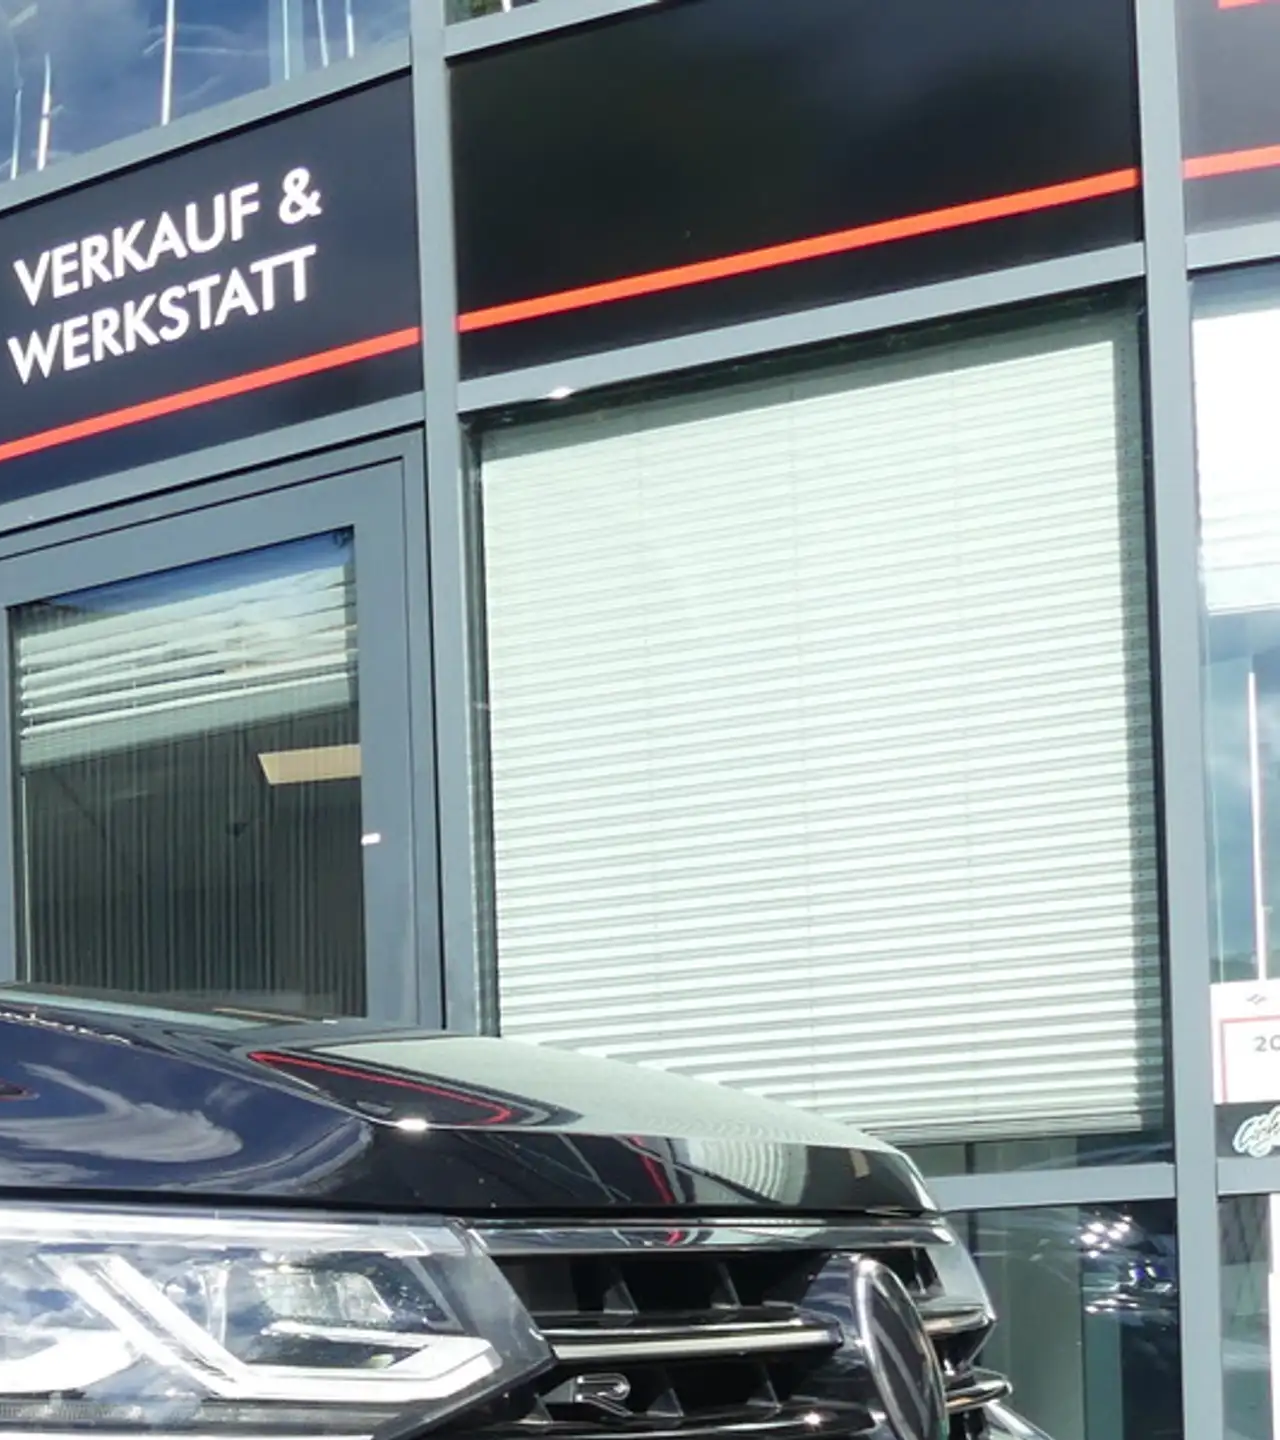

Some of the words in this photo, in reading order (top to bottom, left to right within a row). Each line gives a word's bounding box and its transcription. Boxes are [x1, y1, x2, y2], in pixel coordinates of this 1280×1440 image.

[13, 180, 261, 308] VERKAUF
[278, 166, 322, 225] &
[7, 244, 318, 386] WERKSTATT
